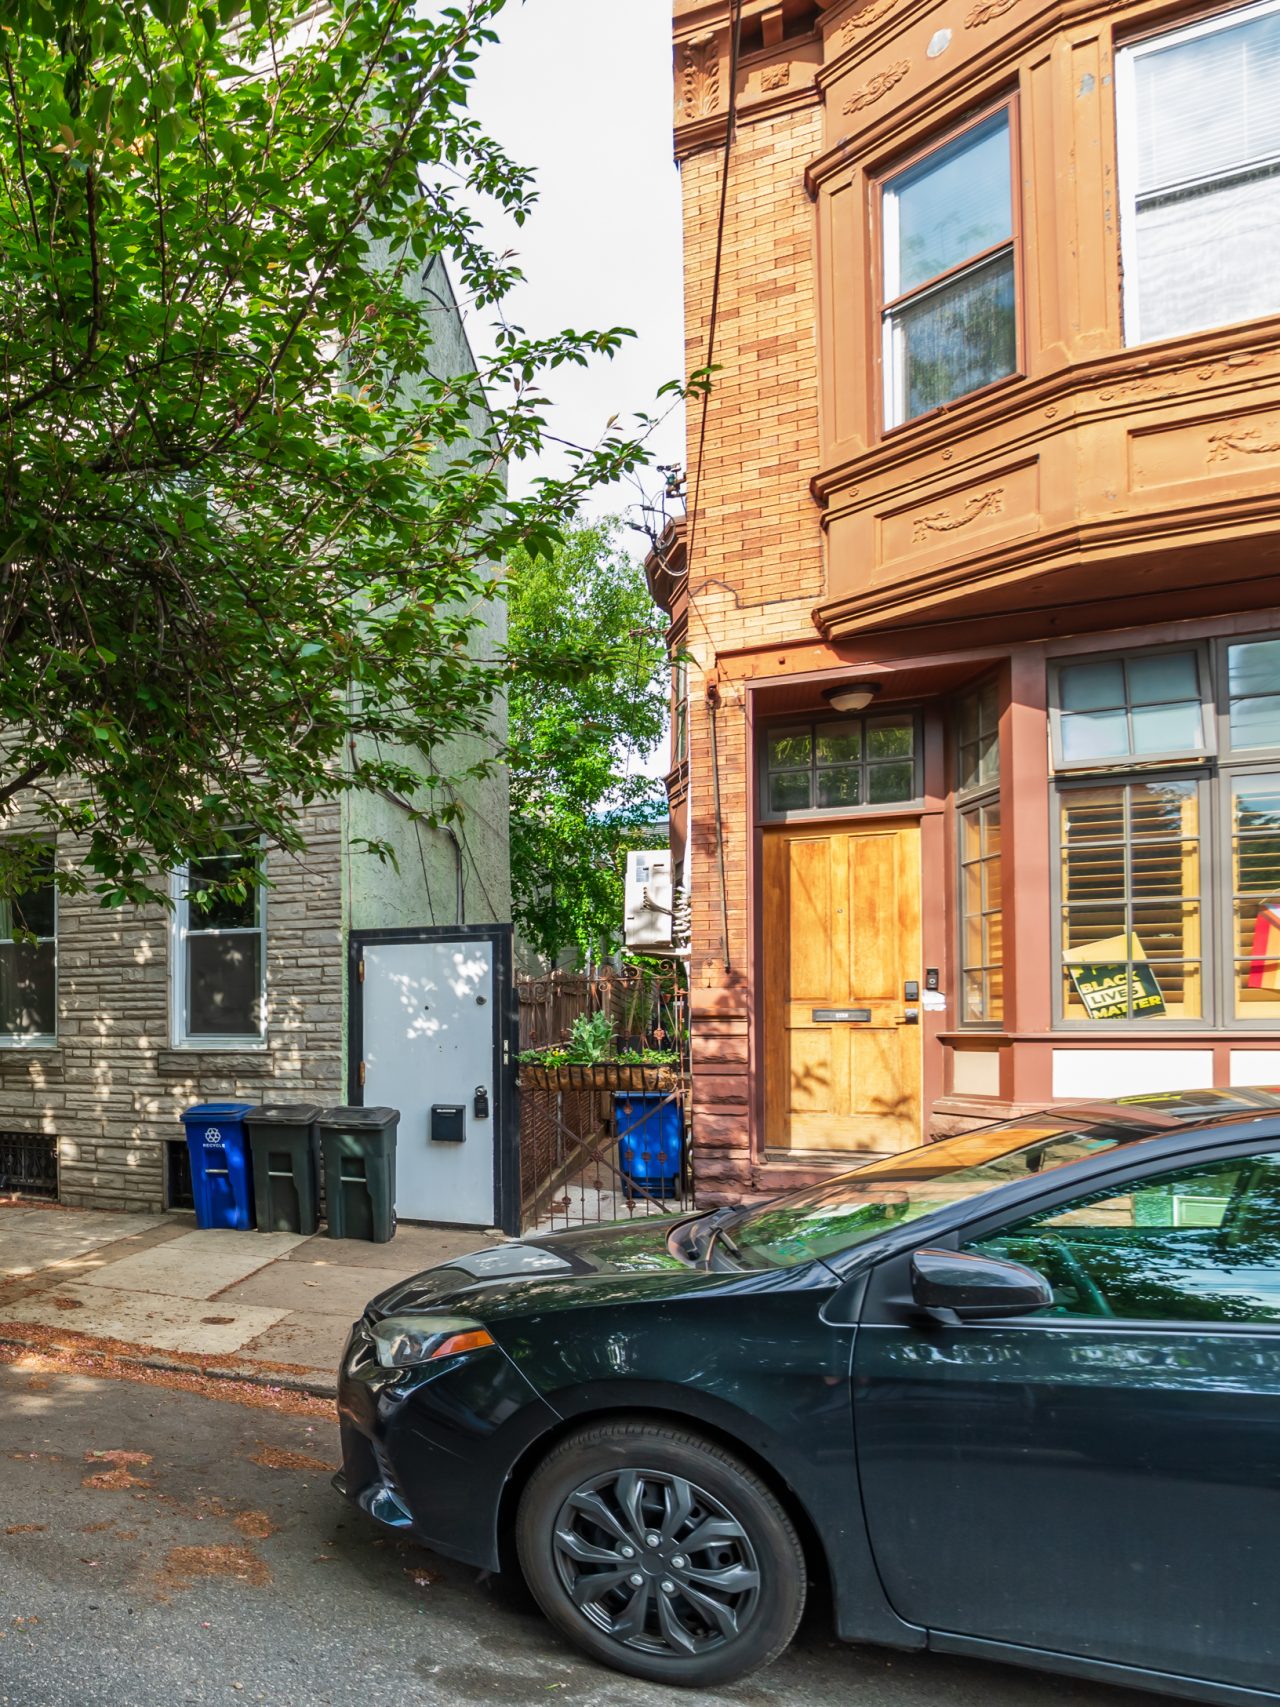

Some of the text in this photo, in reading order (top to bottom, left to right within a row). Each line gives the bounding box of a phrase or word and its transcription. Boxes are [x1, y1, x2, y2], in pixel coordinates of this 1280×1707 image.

[1080, 971, 1141, 994] BLACK
[1090, 985, 1139, 1005] LIVES
[1091, 995, 1163, 1019] MATTER
